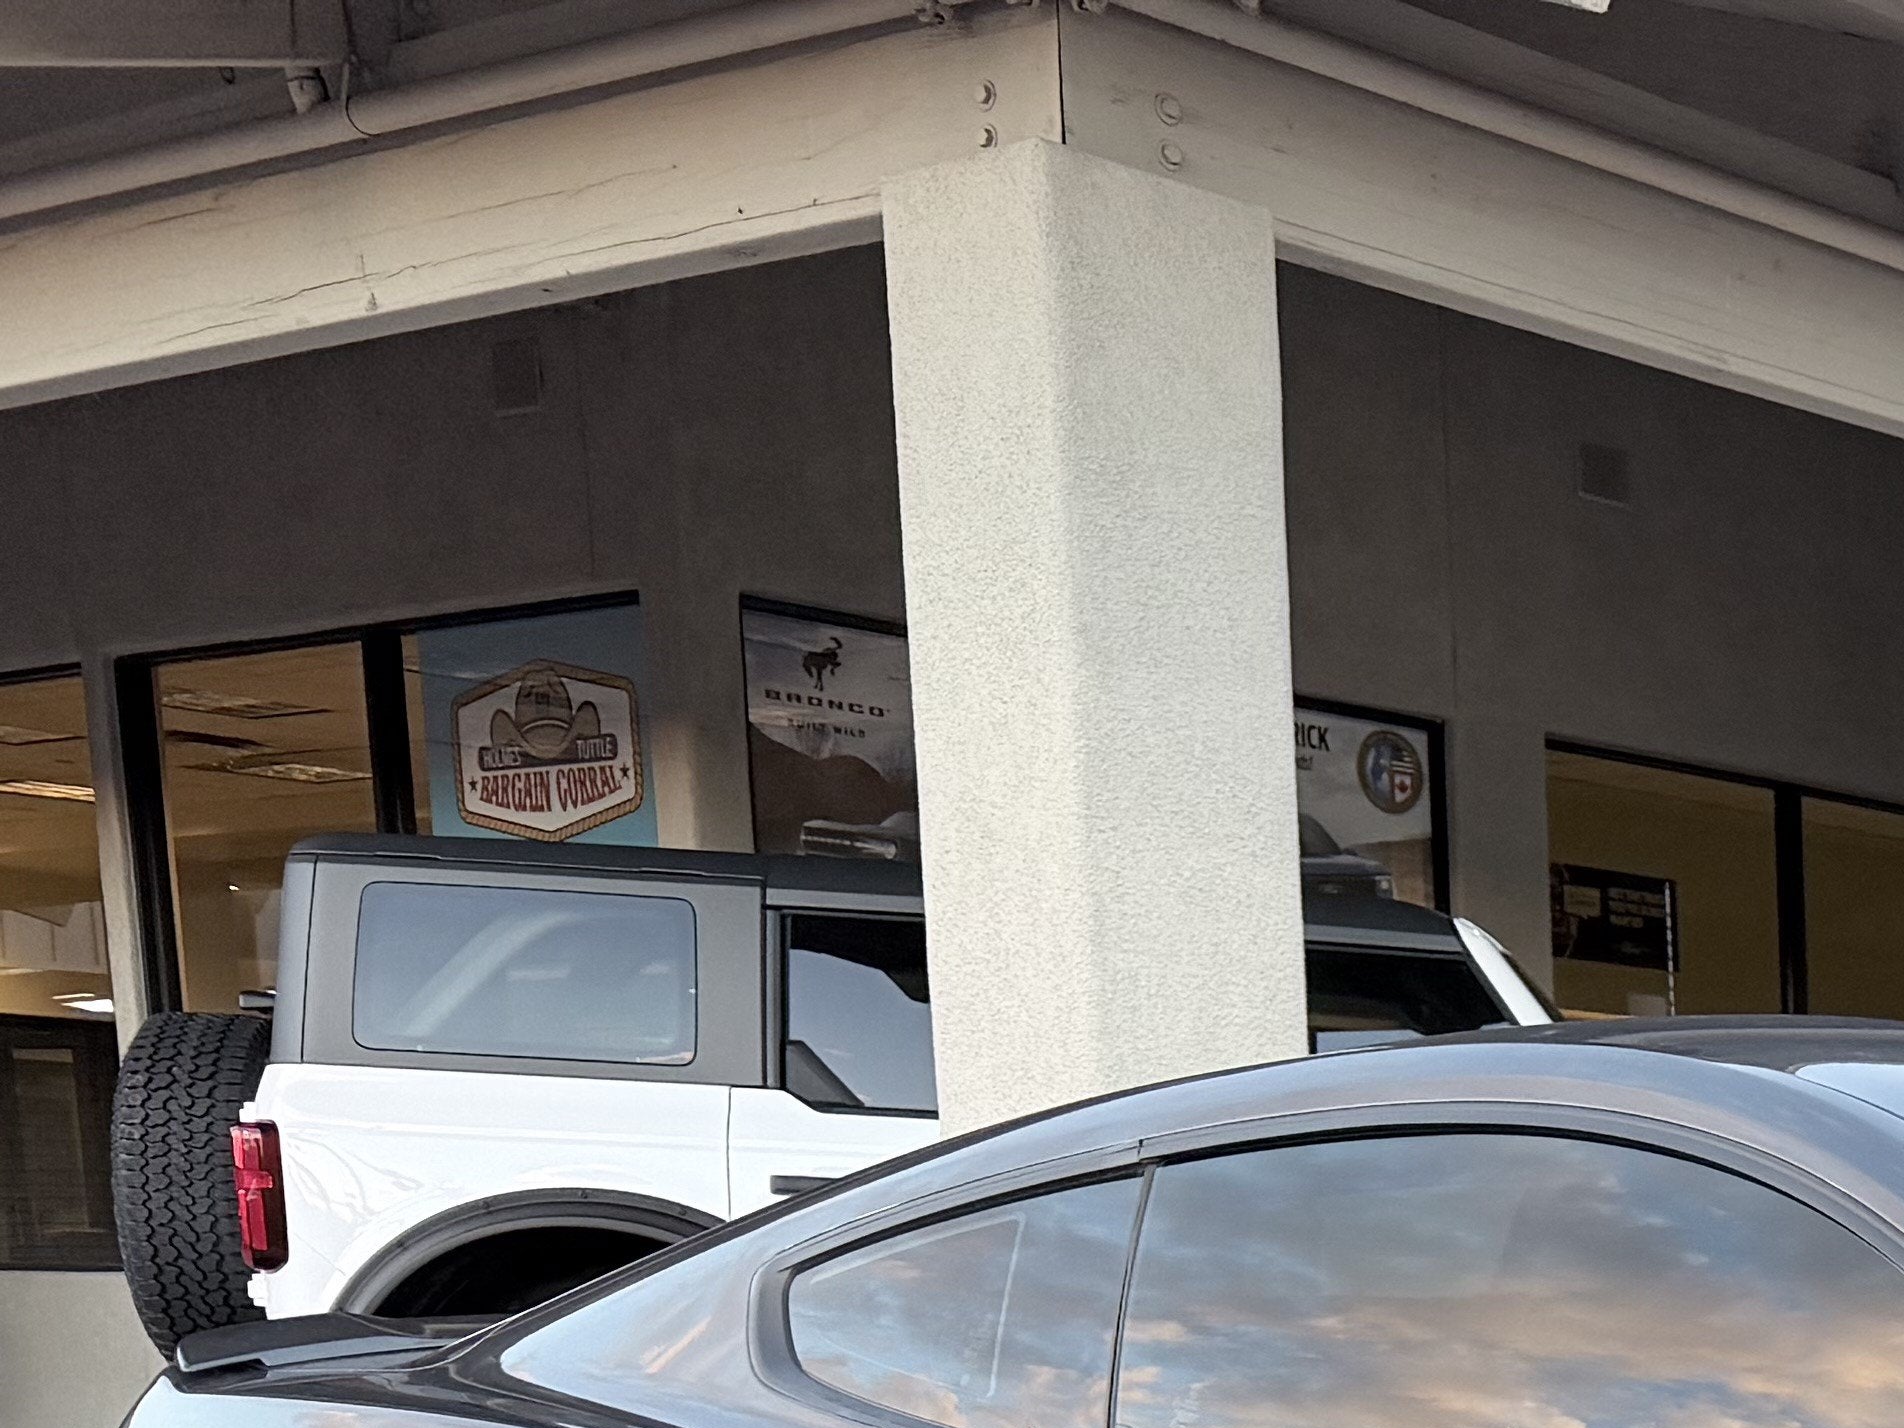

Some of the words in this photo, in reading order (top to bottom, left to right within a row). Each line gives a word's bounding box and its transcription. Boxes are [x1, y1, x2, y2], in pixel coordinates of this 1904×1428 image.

[764, 688, 885, 718] BRONCO
[575, 736, 614, 760] TUTTLE
[479, 770, 553, 813] BARGAIN
[556, 764, 623, 813] CORRAL
